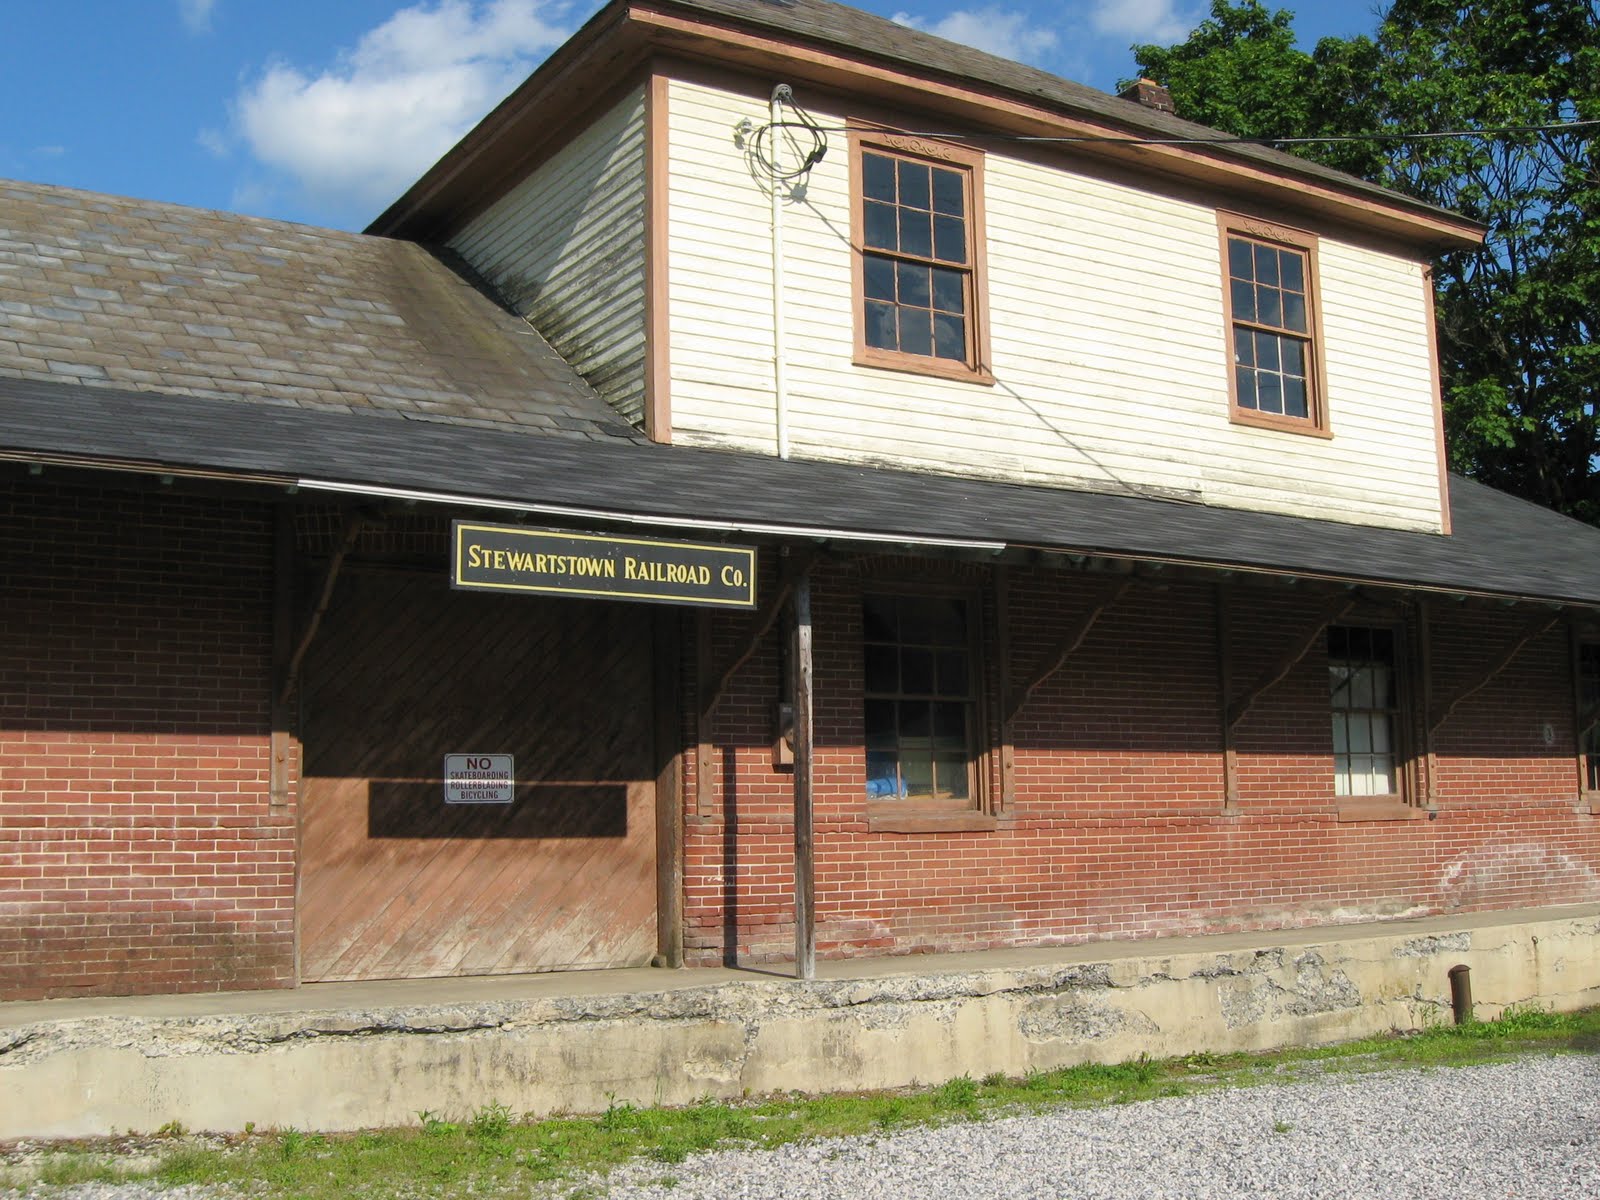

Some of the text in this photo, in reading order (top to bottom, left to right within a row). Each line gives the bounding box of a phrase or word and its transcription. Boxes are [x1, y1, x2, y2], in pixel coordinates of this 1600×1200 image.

[466, 758, 492, 770] NO
[450, 771, 509, 780] SKATEBOARDING
[450, 781, 509, 790] ROLLERBLADING
[460, 791, 499, 799] BICYCLING
